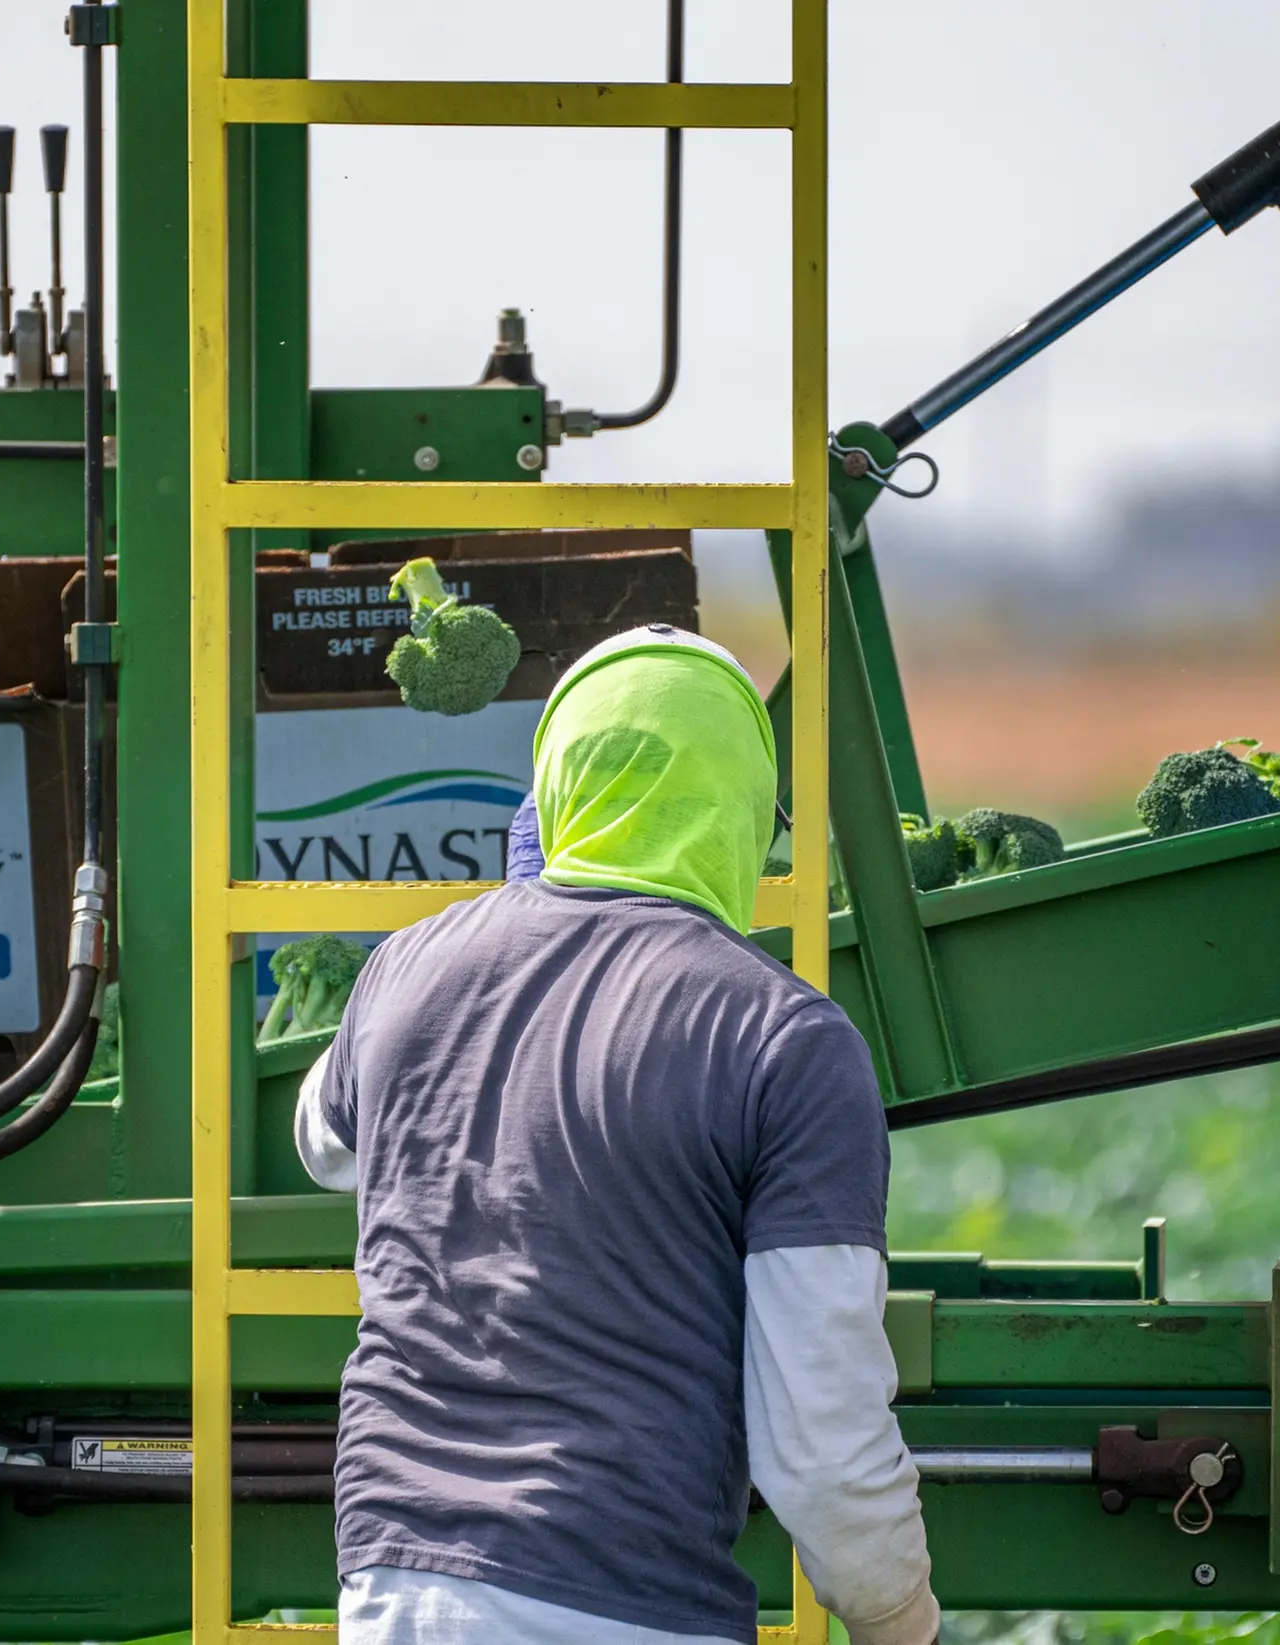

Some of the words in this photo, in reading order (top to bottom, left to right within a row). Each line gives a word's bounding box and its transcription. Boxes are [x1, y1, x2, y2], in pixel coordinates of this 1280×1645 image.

[293, 587, 360, 607] FRESH
[272, 610, 352, 631] PLEASE
[327, 636, 377, 657] 34°F
